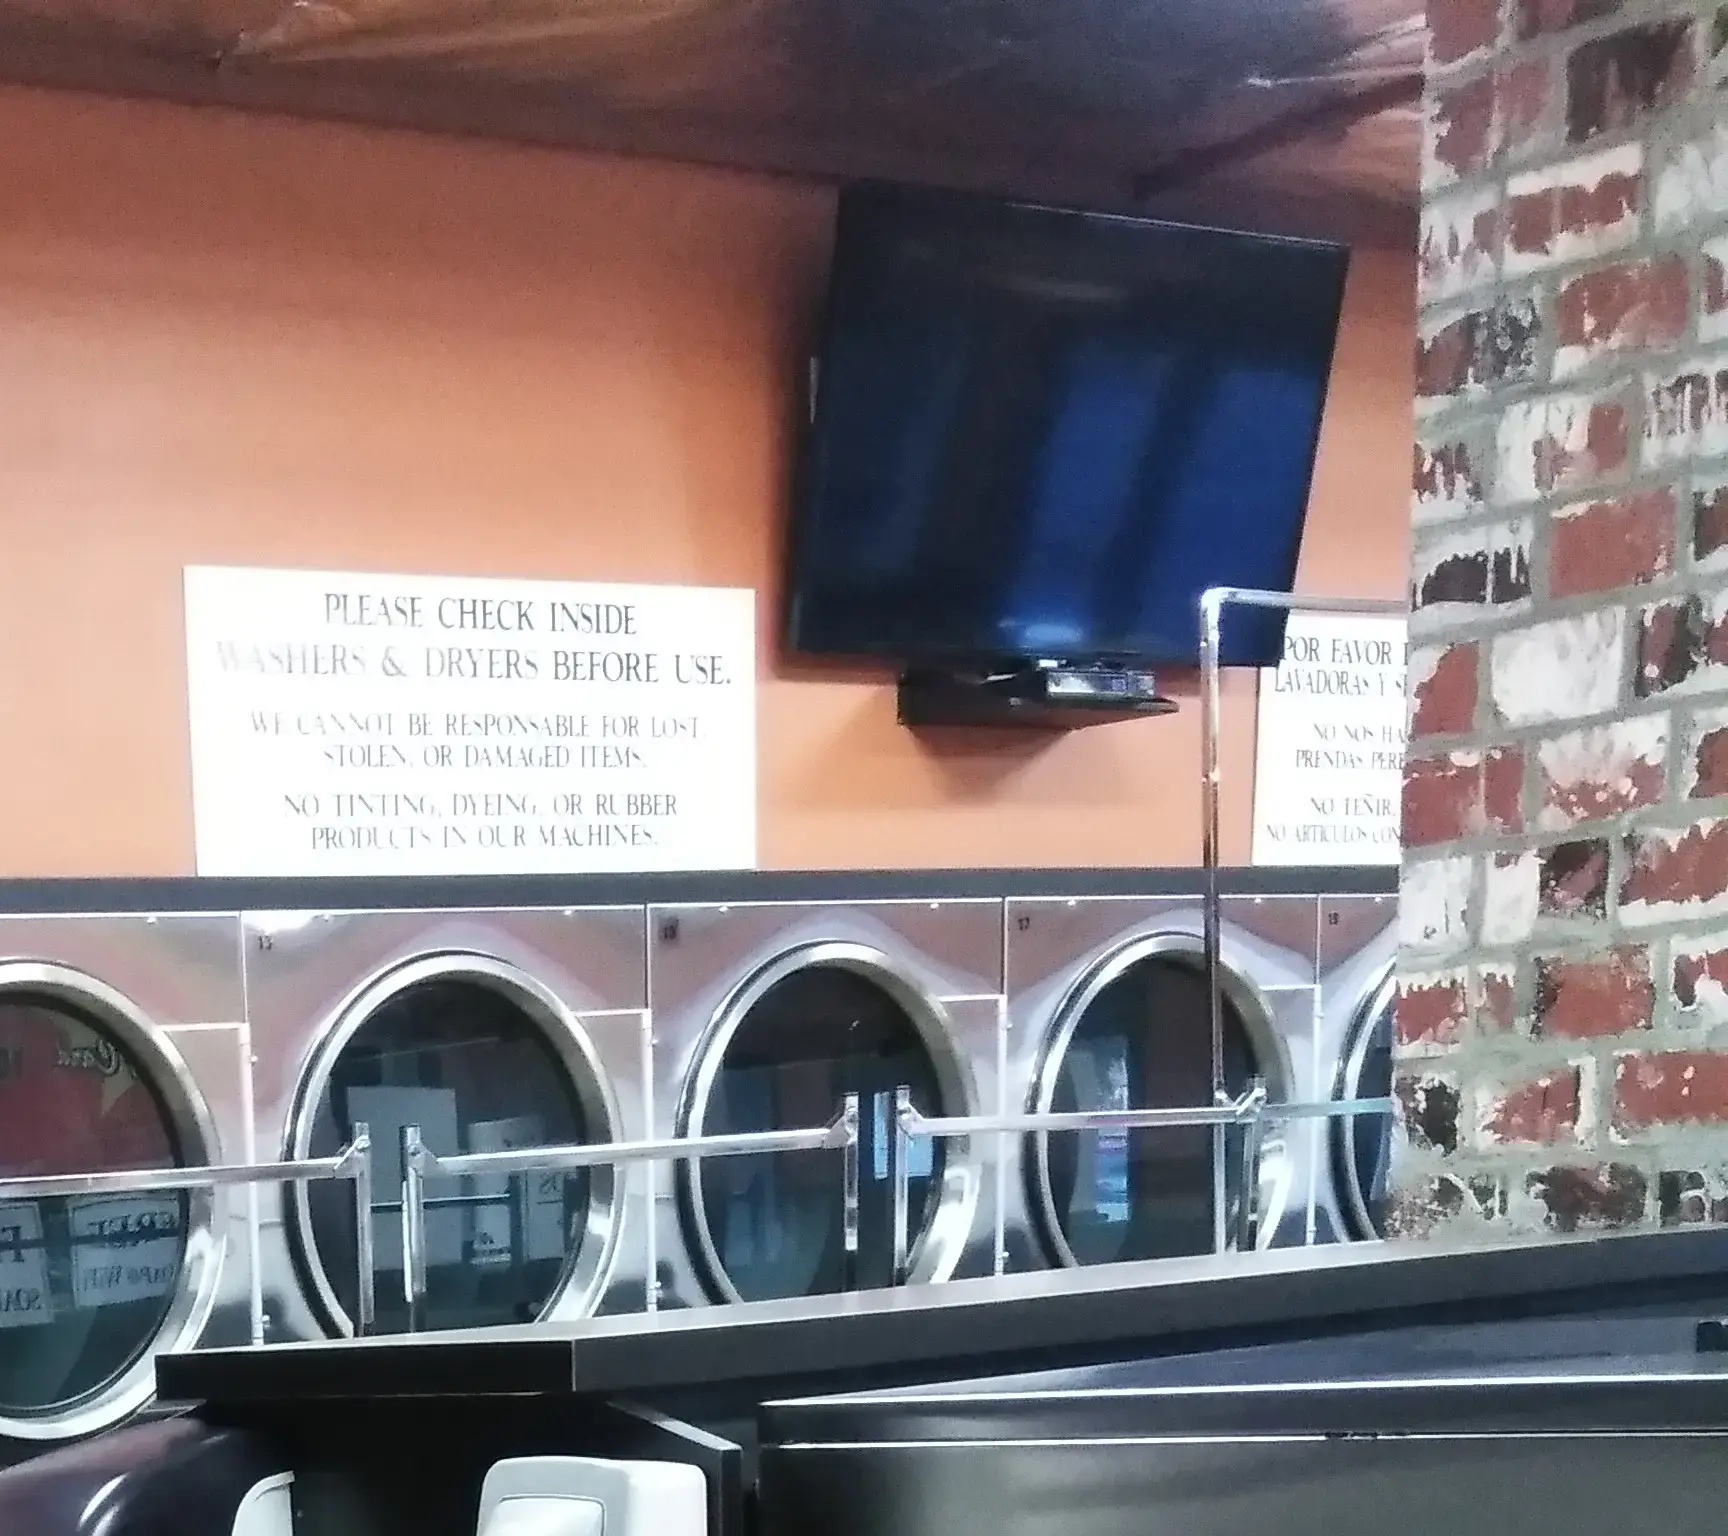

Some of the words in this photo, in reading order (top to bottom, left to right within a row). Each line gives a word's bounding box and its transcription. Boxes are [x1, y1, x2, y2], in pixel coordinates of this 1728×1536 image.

[324, 593, 423, 628] PLEASE
[438, 597, 535, 631] CHECK
[550, 602, 637, 635] INSIDE
[216, 641, 367, 675] WASHERS
[381, 645, 408, 677] &
[425, 647, 539, 680] DRYERS
[552, 650, 659, 682] BEFORE
[674, 654, 732, 684] USE.
[1283, 635, 1321, 662] POR
[1331, 638, 1392, 666] FAVOR
[1274, 667, 1370, 696] LAVADORAS
[1378, 672, 1388, 696] Y
[297, 713, 394, 736] CANNOT
[409, 713, 433, 736] BE
[602, 715, 639, 738] FOR
[1313, 722, 1336, 741] NO
[1345, 724, 1374, 742] NOS
[423, 745, 452, 768] OR
[465, 745, 570, 768] DAMAGED
[1296, 749, 1363, 769] PRENDAS
[284, 794, 320, 817] NO
[553, 794, 583, 816] OR
[595, 794, 677, 816] RUBBER
[1310, 797, 1334, 815] NO
[312, 826, 431, 849] PRODUCTS
[443, 825, 467, 848] IN
[478, 824, 527, 848] OUR
[1266, 824, 1286, 842] NO
